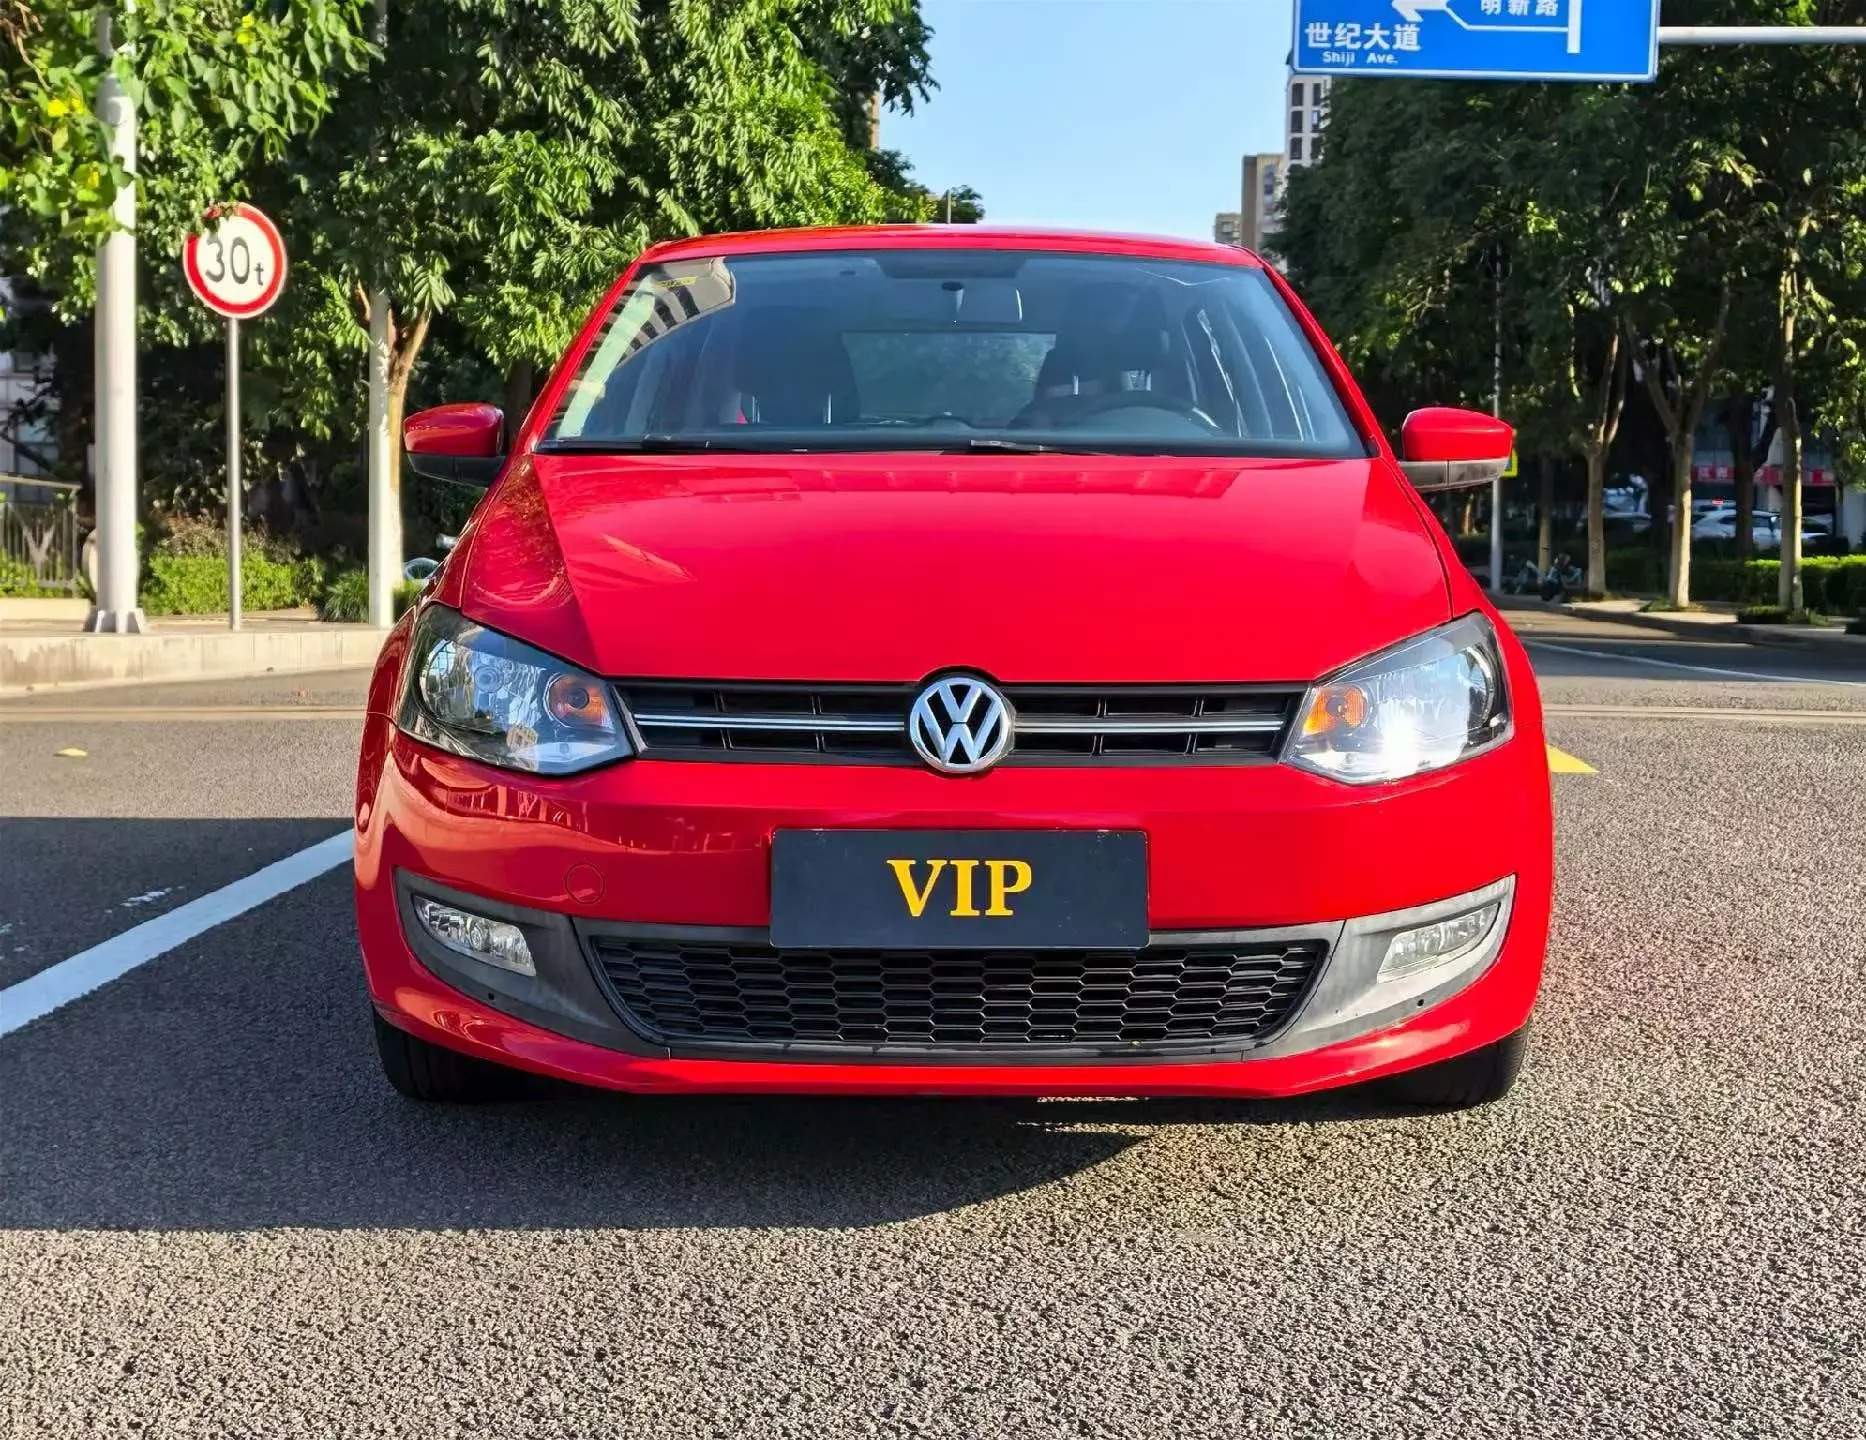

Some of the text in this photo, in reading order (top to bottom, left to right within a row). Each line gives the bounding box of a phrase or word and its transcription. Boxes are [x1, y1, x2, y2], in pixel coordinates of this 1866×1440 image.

[1304, 22, 1421, 51] 世纪大道
[1322, 51, 1355, 66] Shiji
[887, 859, 1032, 917] VIP
